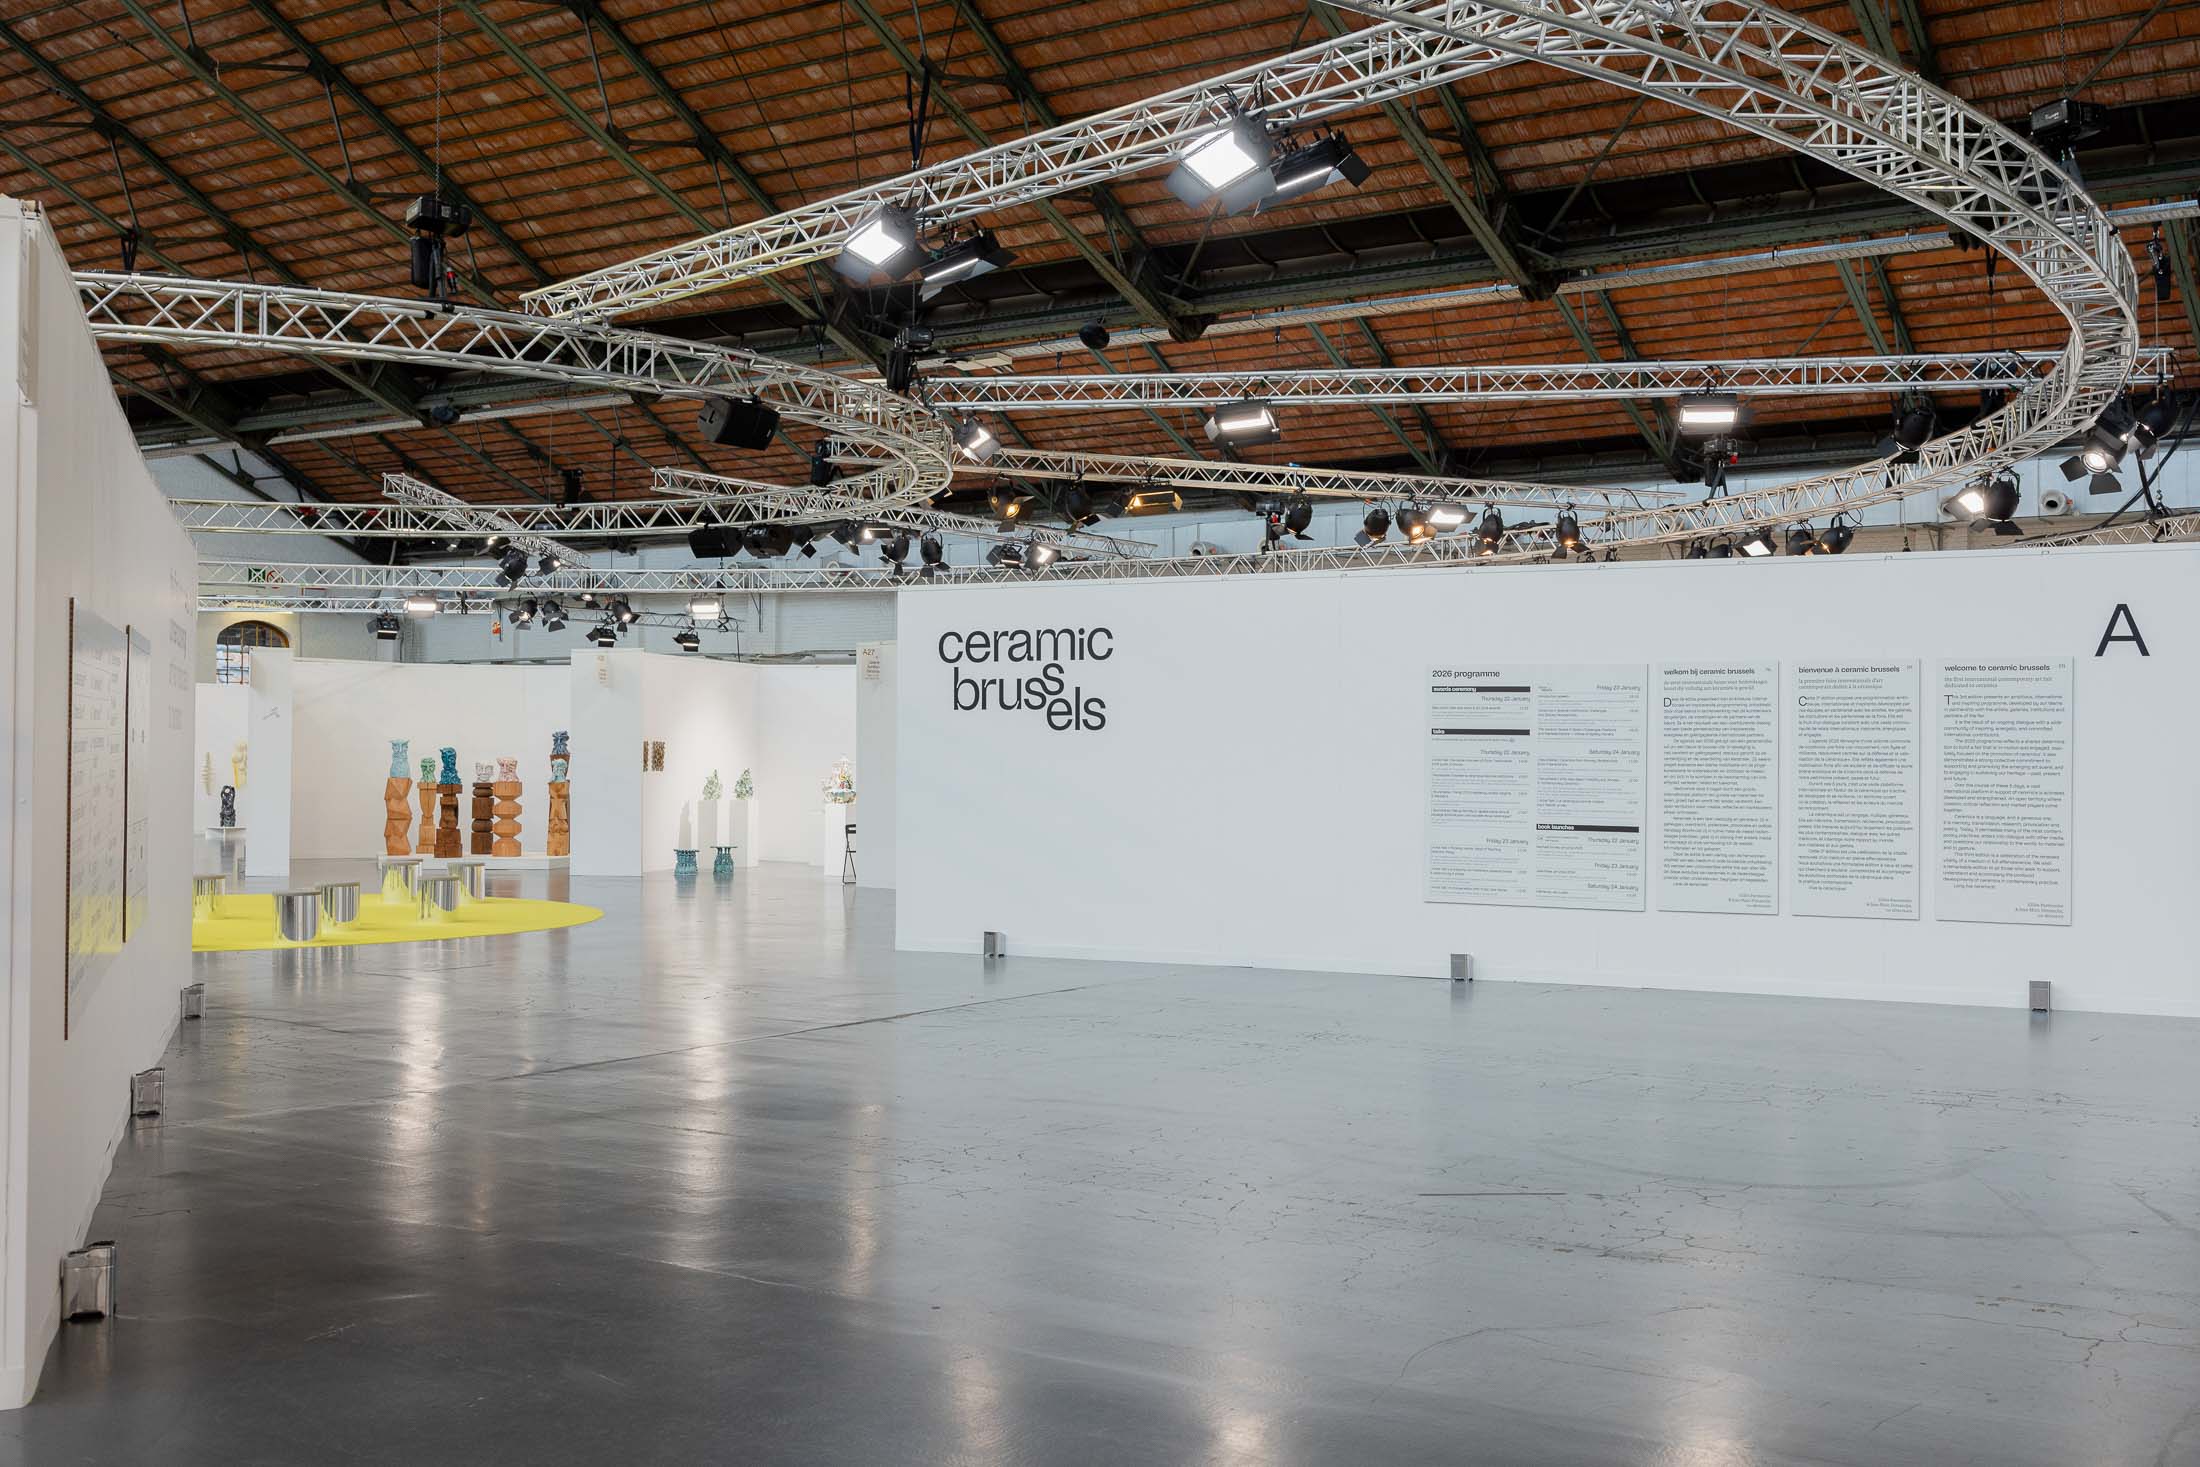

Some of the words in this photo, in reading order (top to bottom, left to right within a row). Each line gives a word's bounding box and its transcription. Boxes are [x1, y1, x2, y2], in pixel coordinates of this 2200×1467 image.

[2094, 603, 2150, 657] A
[938, 627, 1114, 663] ceramic
[1432, 670, 1453, 678] 2026
[1454, 671, 1501, 679] programme
[1699, 667, 1726, 675] ceramic
[1727, 667, 1756, 675] brussels
[1944, 664, 1977, 672] welcome
[953, 662, 1106, 731] brussels
